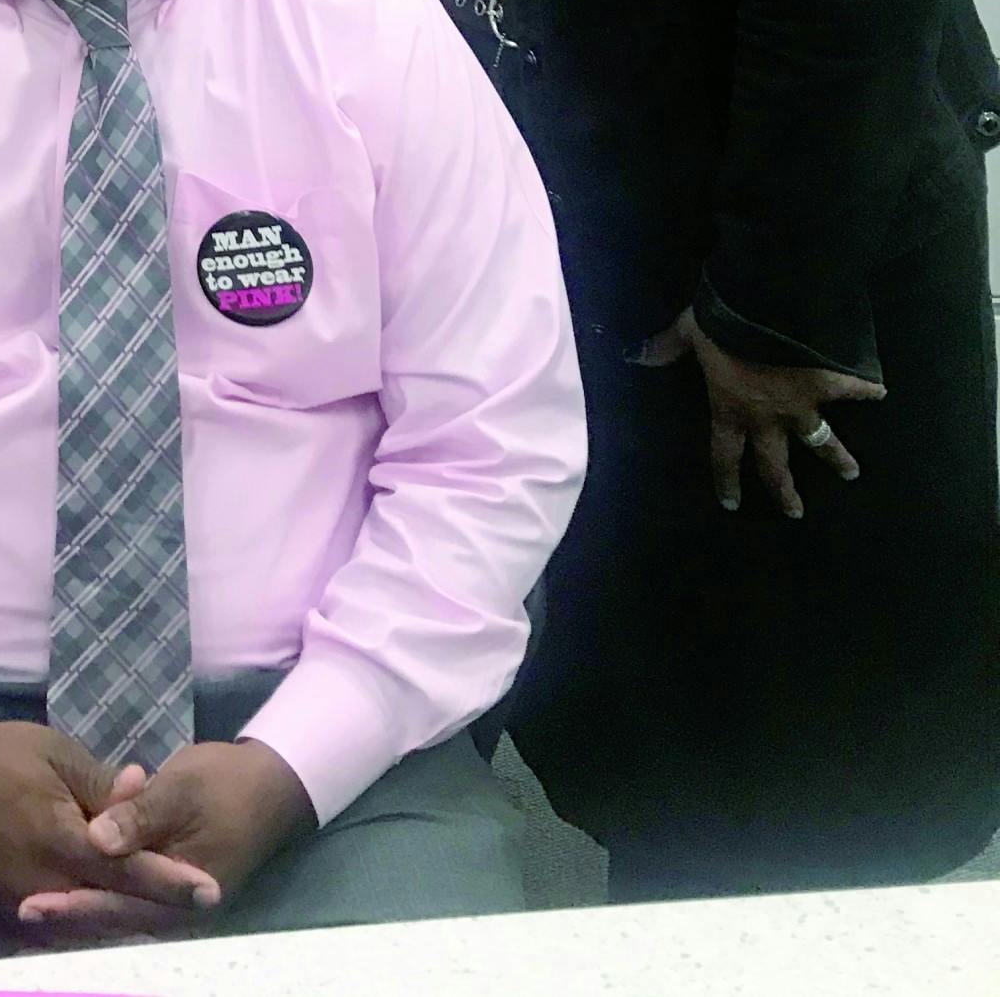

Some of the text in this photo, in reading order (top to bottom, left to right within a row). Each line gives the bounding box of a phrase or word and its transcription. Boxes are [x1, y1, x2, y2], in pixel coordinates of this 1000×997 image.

[211, 225, 282, 252] MAN
[200, 243, 304, 272] enough
[205, 266, 306, 291] to wear
[216, 283, 304, 311] PINK!
